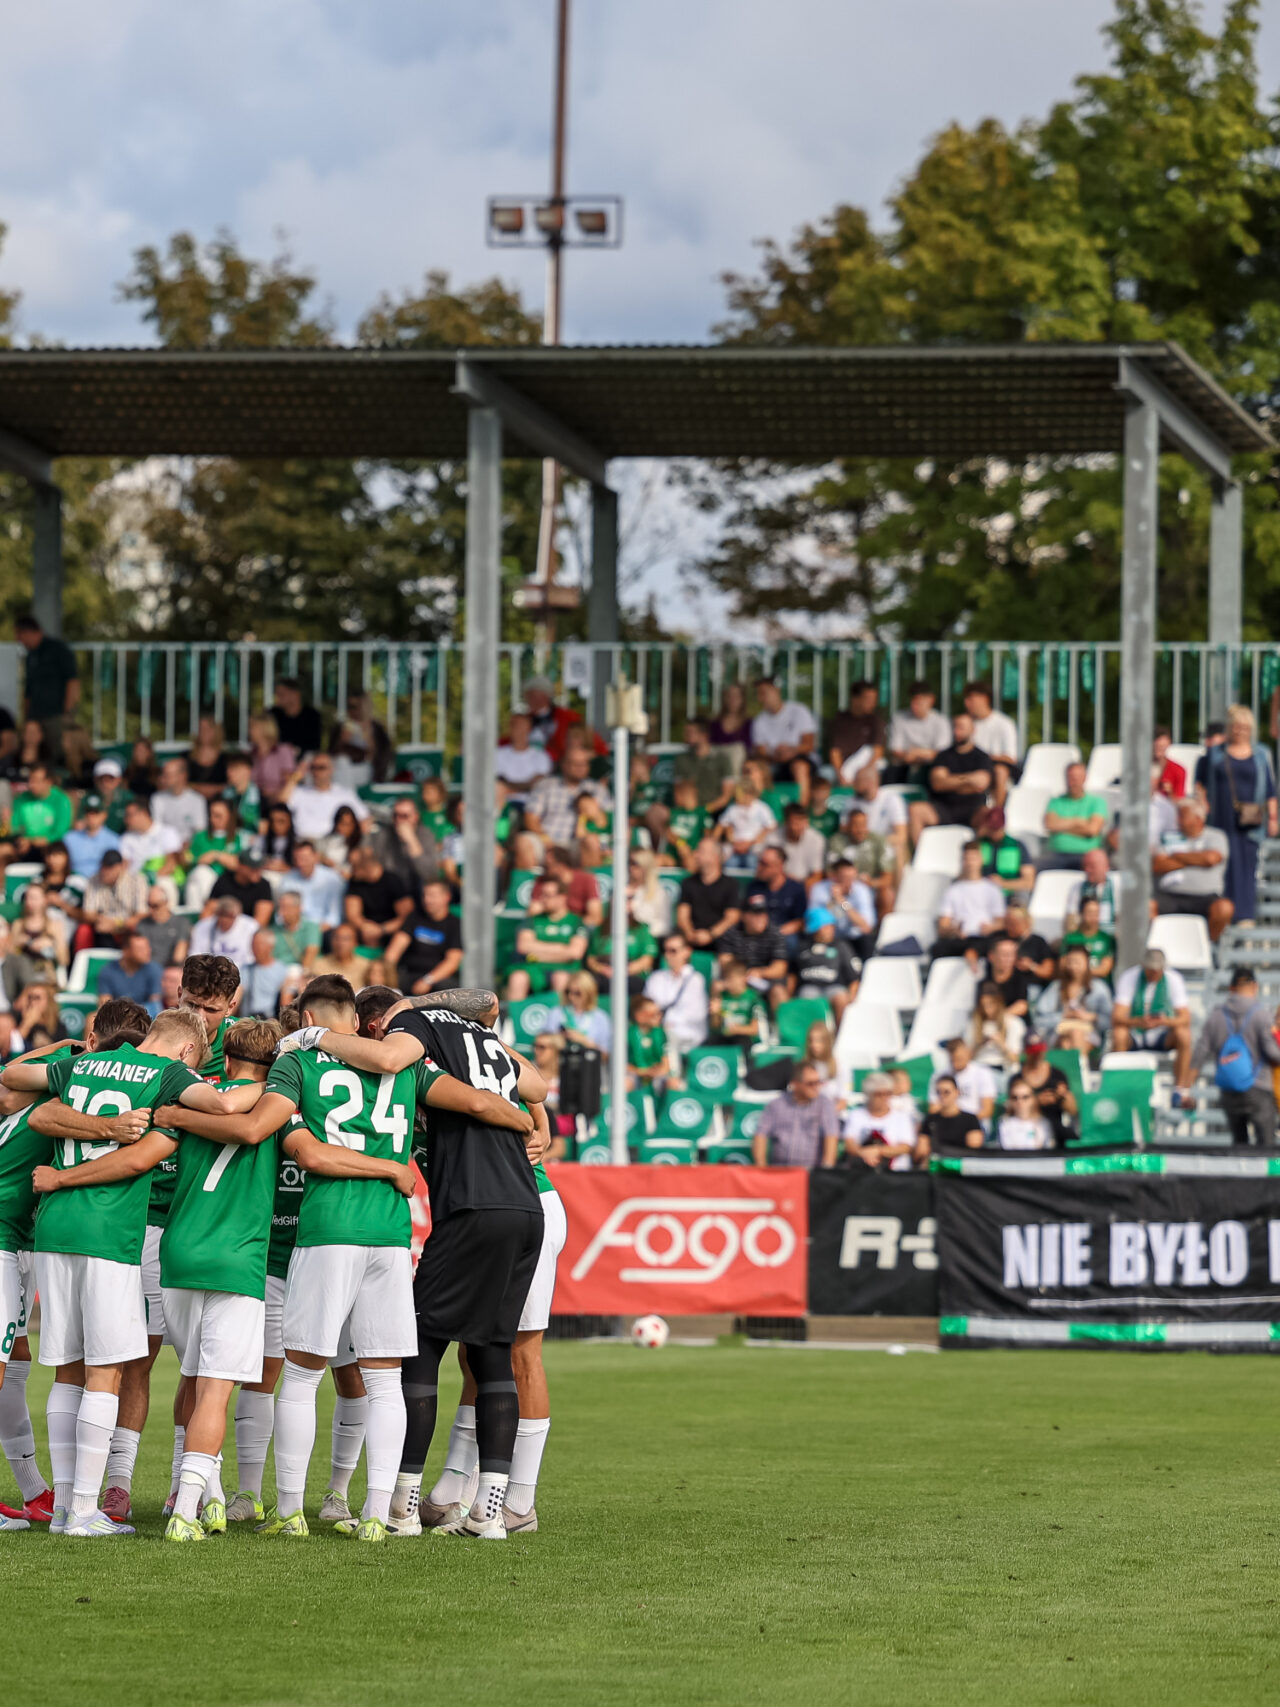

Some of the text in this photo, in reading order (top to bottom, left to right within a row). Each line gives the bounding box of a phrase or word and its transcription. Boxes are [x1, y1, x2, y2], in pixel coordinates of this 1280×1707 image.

[73, 1060, 159, 1084] SZYMANEK
[463, 1033, 519, 1109] 42
[319, 1070, 408, 1154] 24
[1002, 1223, 1091, 1288] NIE
[1109, 1219, 1249, 1287] BYŁO
[1, 1321, 17, 1355] 8
